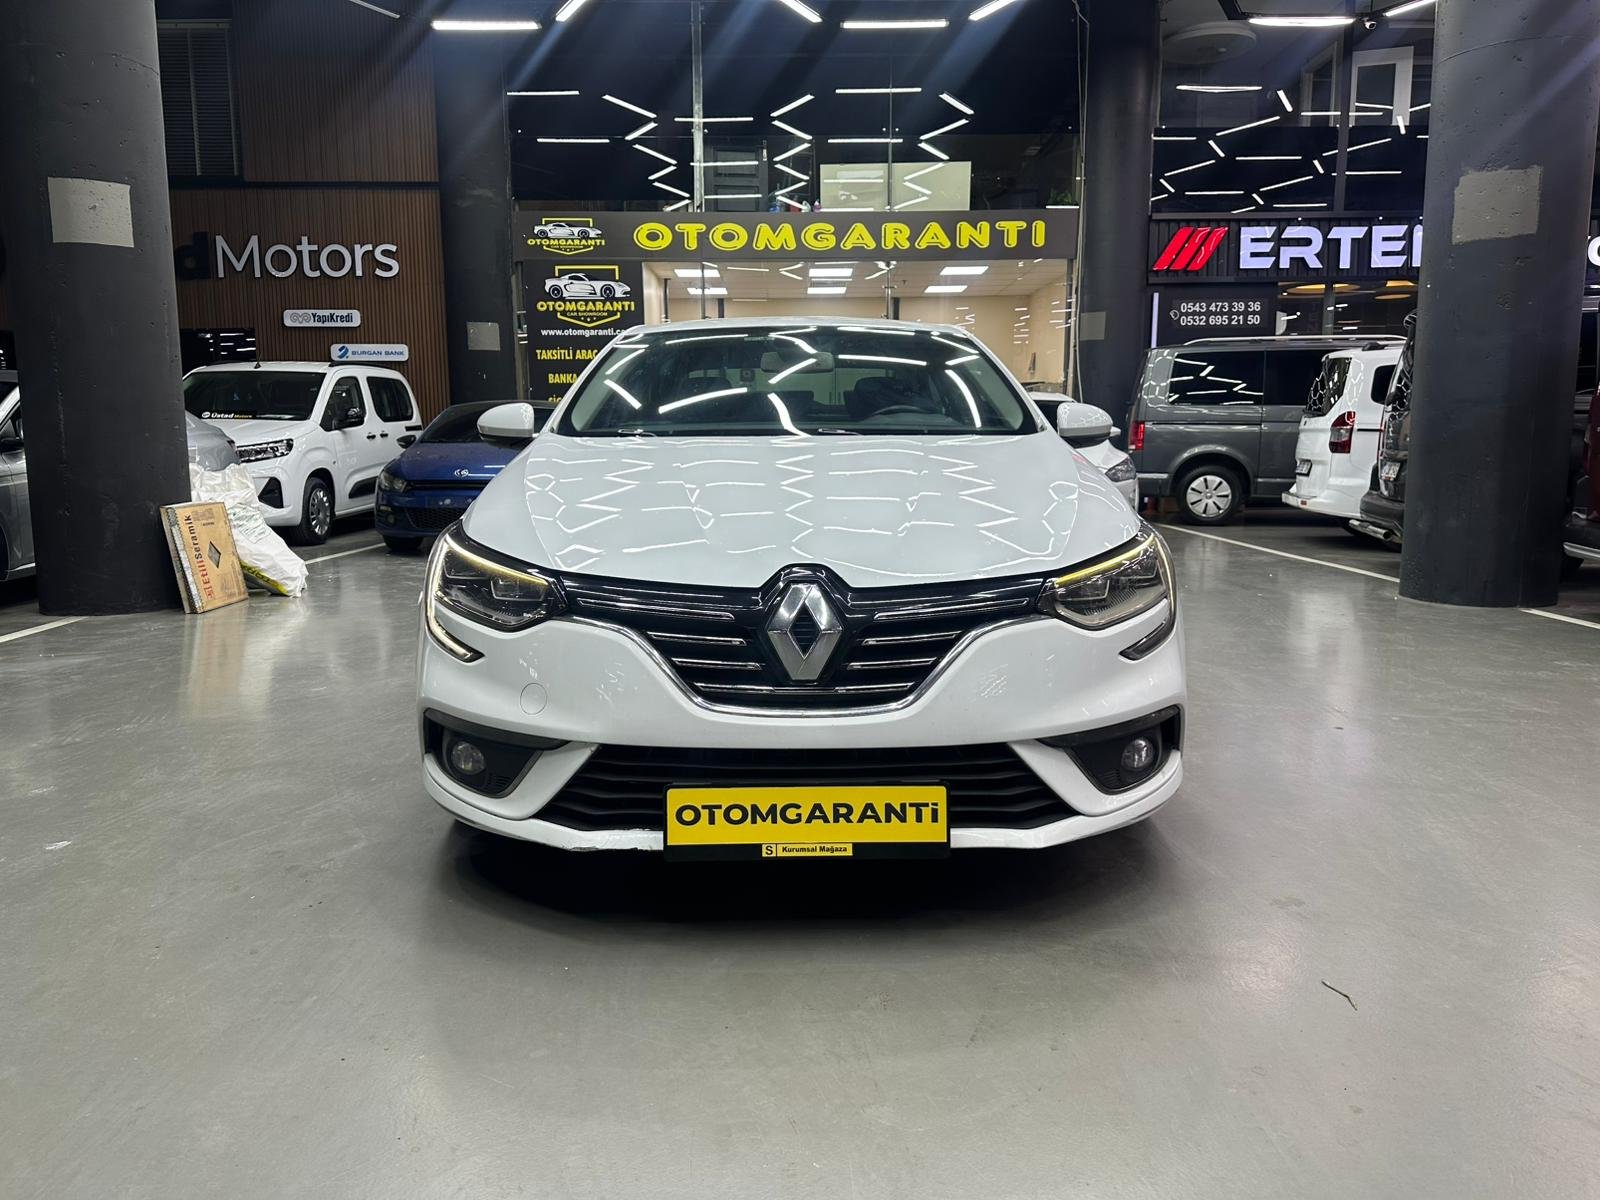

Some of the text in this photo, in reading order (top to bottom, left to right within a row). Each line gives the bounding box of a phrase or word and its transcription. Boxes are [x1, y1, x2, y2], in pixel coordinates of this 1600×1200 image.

[632, 220, 1047, 251] OTOMGARANTI
[527, 238, 606, 246] OTOMGARANTI
[215, 234, 400, 278] Motors
[536, 301, 635, 312] OTOMGARANTI
[1180, 301, 1261, 313] 0543 473 39 36
[1179, 314, 1261, 326] 0532 695 21 50
[819, 846, 848, 855] Mağaza
